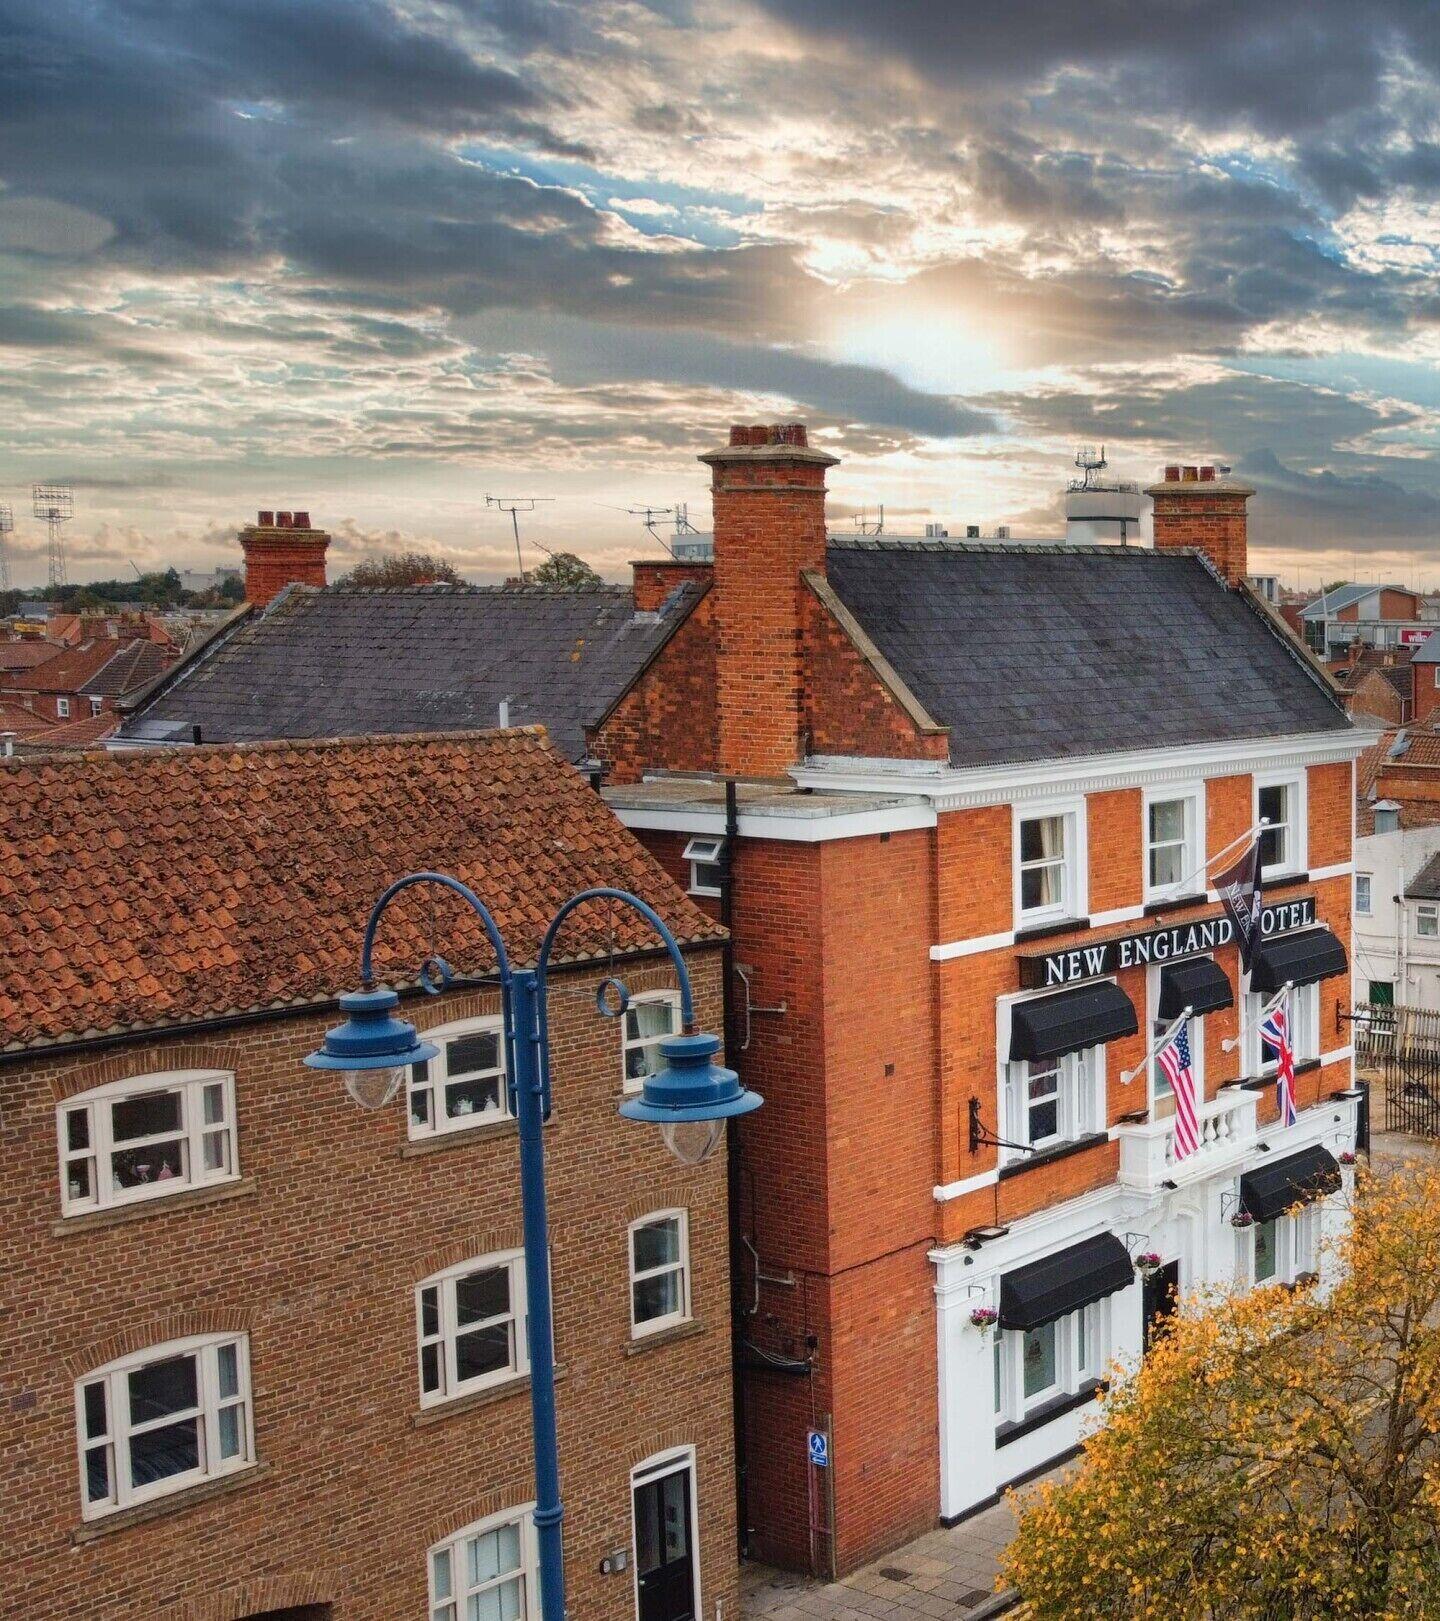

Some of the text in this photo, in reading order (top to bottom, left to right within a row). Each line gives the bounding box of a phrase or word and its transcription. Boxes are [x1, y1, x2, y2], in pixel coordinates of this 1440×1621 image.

[1046, 945, 1107, 986] NEW
[1119, 918, 1233, 969] ENGLAND
[1261, 901, 1312, 935] OTEL
